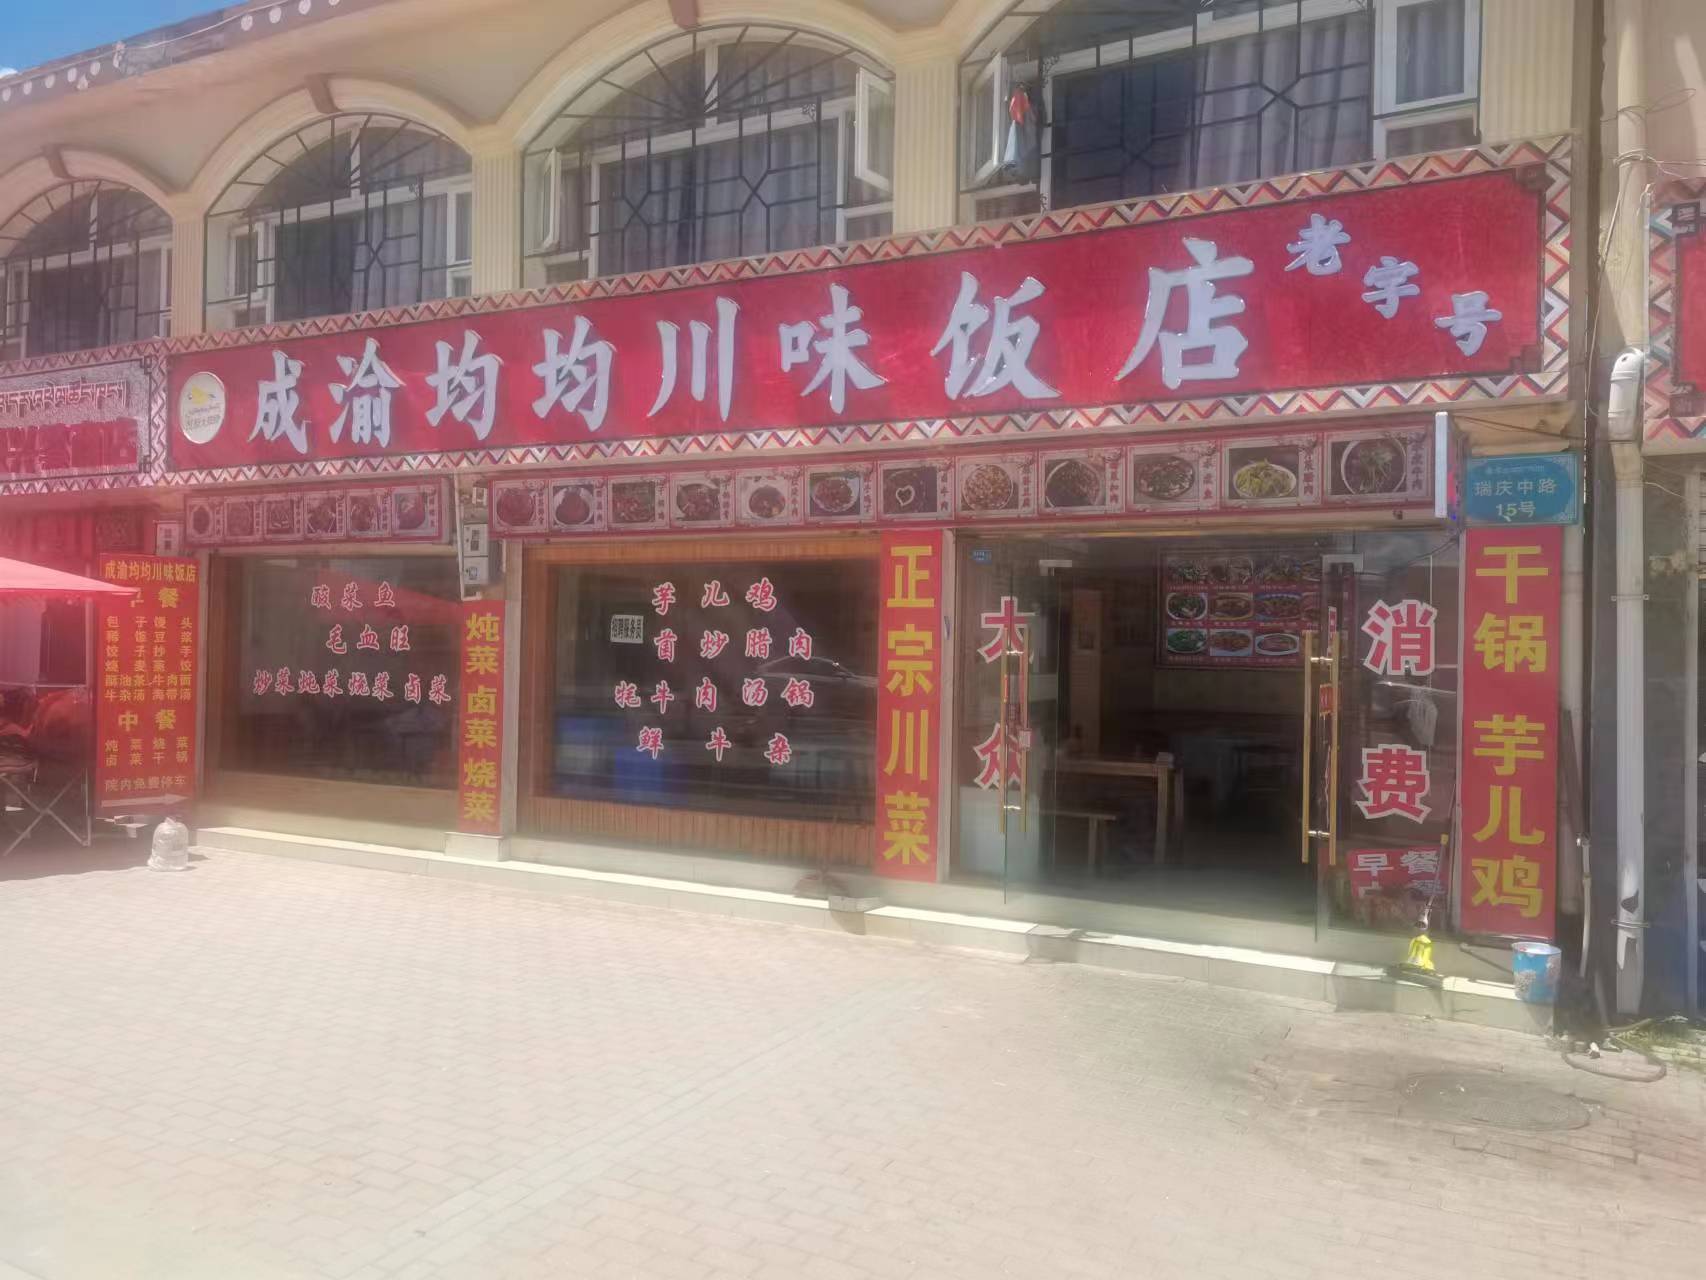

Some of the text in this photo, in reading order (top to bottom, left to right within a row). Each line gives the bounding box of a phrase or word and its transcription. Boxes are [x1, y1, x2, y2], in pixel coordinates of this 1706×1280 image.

[1284, 213, 1502, 357] 老字号
[248, 237, 1255, 455] 成渝均均川味饭店
[1495, 501, 1537, 518] 15号
[105, 559, 197, 582] 成渝均均川味饭店
[311, 581, 396, 611] 酸菜鱼
[651, 577, 777, 615] 芋儿鸡
[326, 624, 410, 655] 毛血旺
[614, 677, 815, 714] 牦牛肉汤锅
[884, 546, 936, 865] 正宗川菜
[1356, 599, 1438, 825] 消费
[118, 709, 177, 732] 中餐
[1471, 546, 1549, 918] 干锅芋儿鸡
[636, 726, 793, 766] 鲜牛杂
[1353, 850, 1438, 876] 早餐
